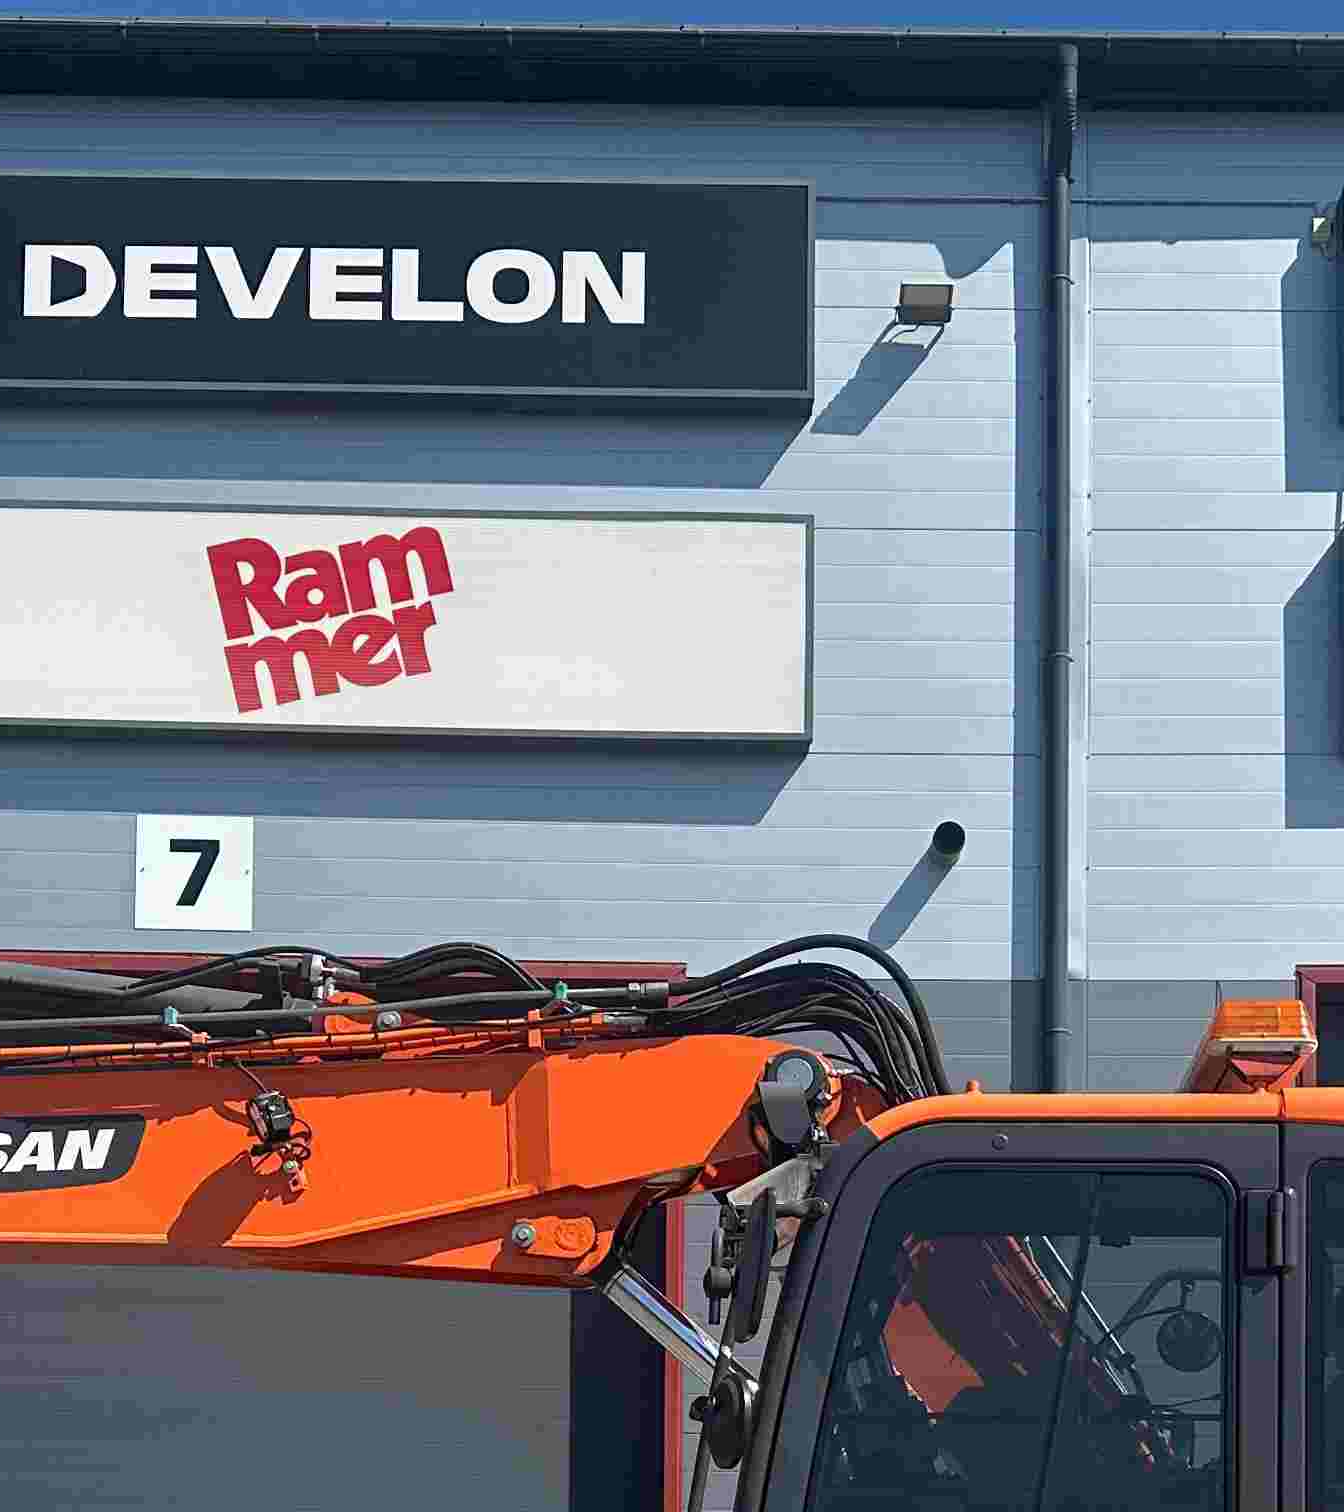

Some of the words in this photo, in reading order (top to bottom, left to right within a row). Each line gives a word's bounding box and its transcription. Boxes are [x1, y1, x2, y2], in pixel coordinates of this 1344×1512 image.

[22, 244, 646, 325] DEVELON
[206, 525, 454, 640] Ram
[223, 605, 438, 713] mer
[169, 838, 221, 907] 7
